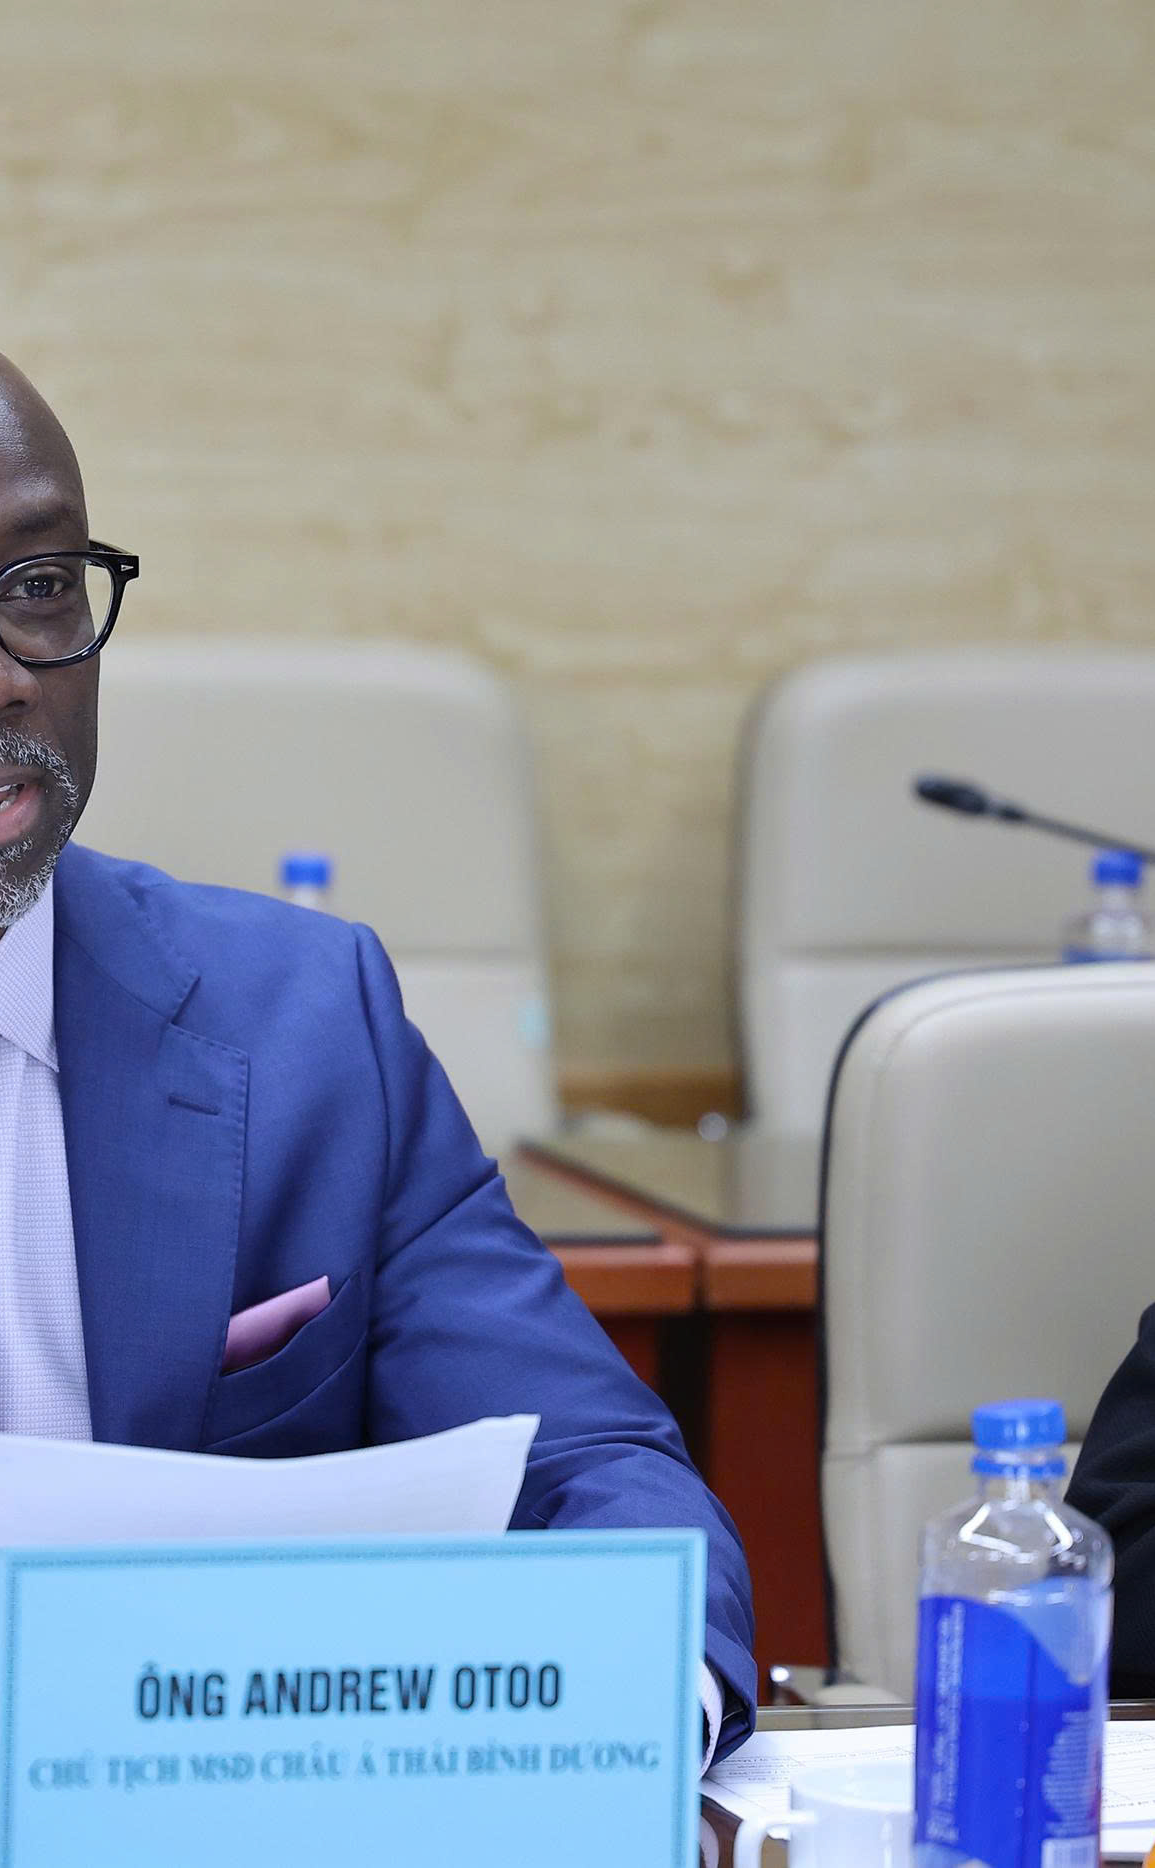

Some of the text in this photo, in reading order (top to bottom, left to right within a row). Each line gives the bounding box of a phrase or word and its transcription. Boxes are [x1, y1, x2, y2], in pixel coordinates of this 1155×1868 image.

[137, 1661, 560, 1720] ÔNG ANDREW OTOO
